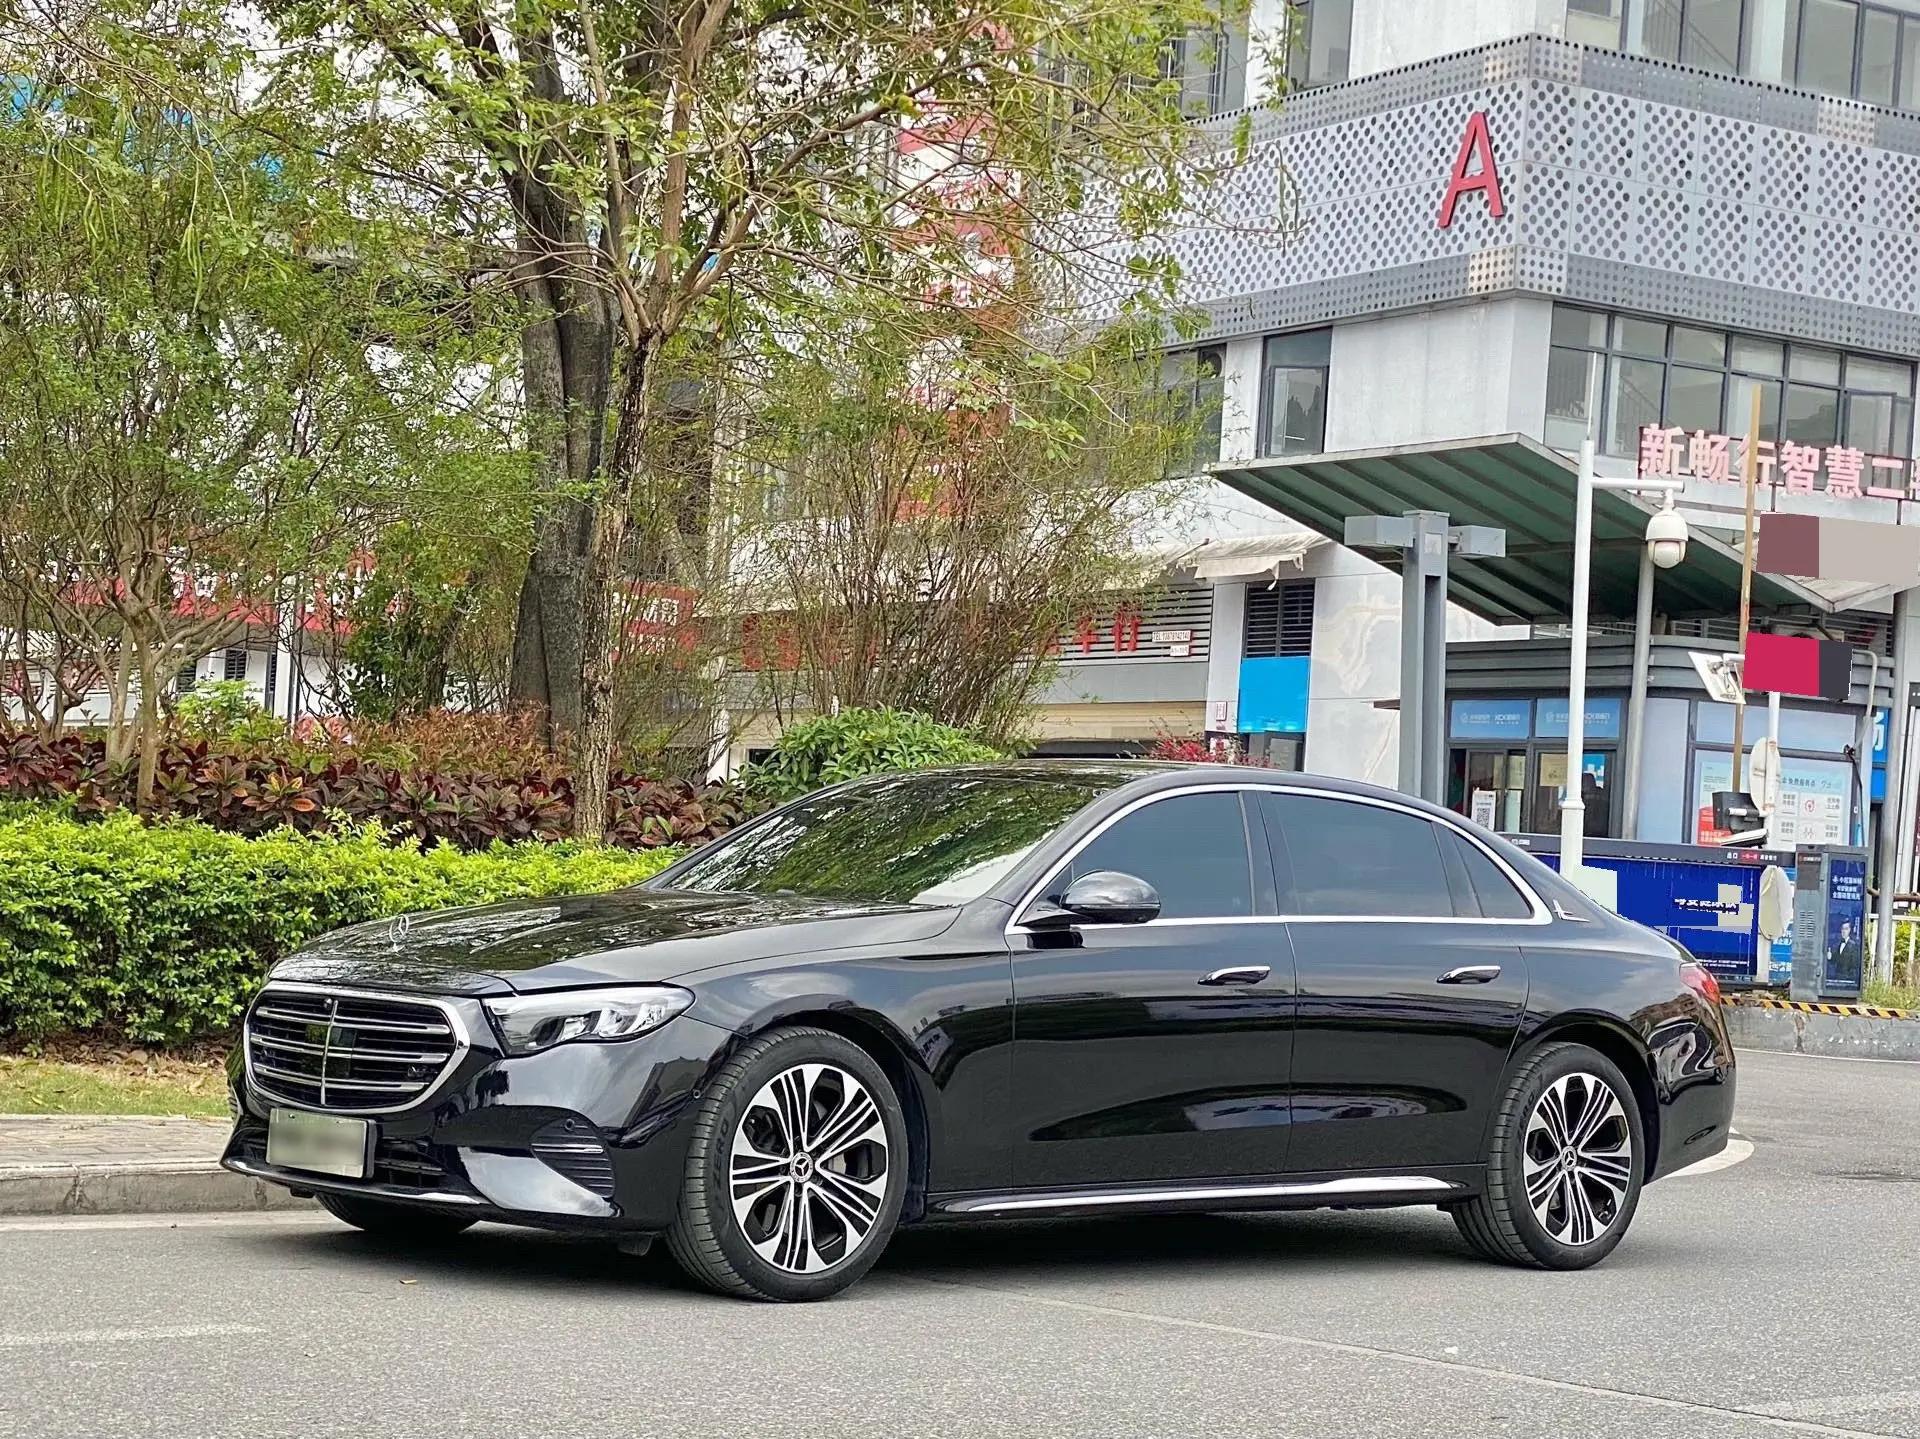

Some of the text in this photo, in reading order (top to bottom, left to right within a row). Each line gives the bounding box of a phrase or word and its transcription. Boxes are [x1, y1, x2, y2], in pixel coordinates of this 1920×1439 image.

[1438, 111, 1505, 229] A
[1640, 423, 1920, 498] 新畅行智慧二
